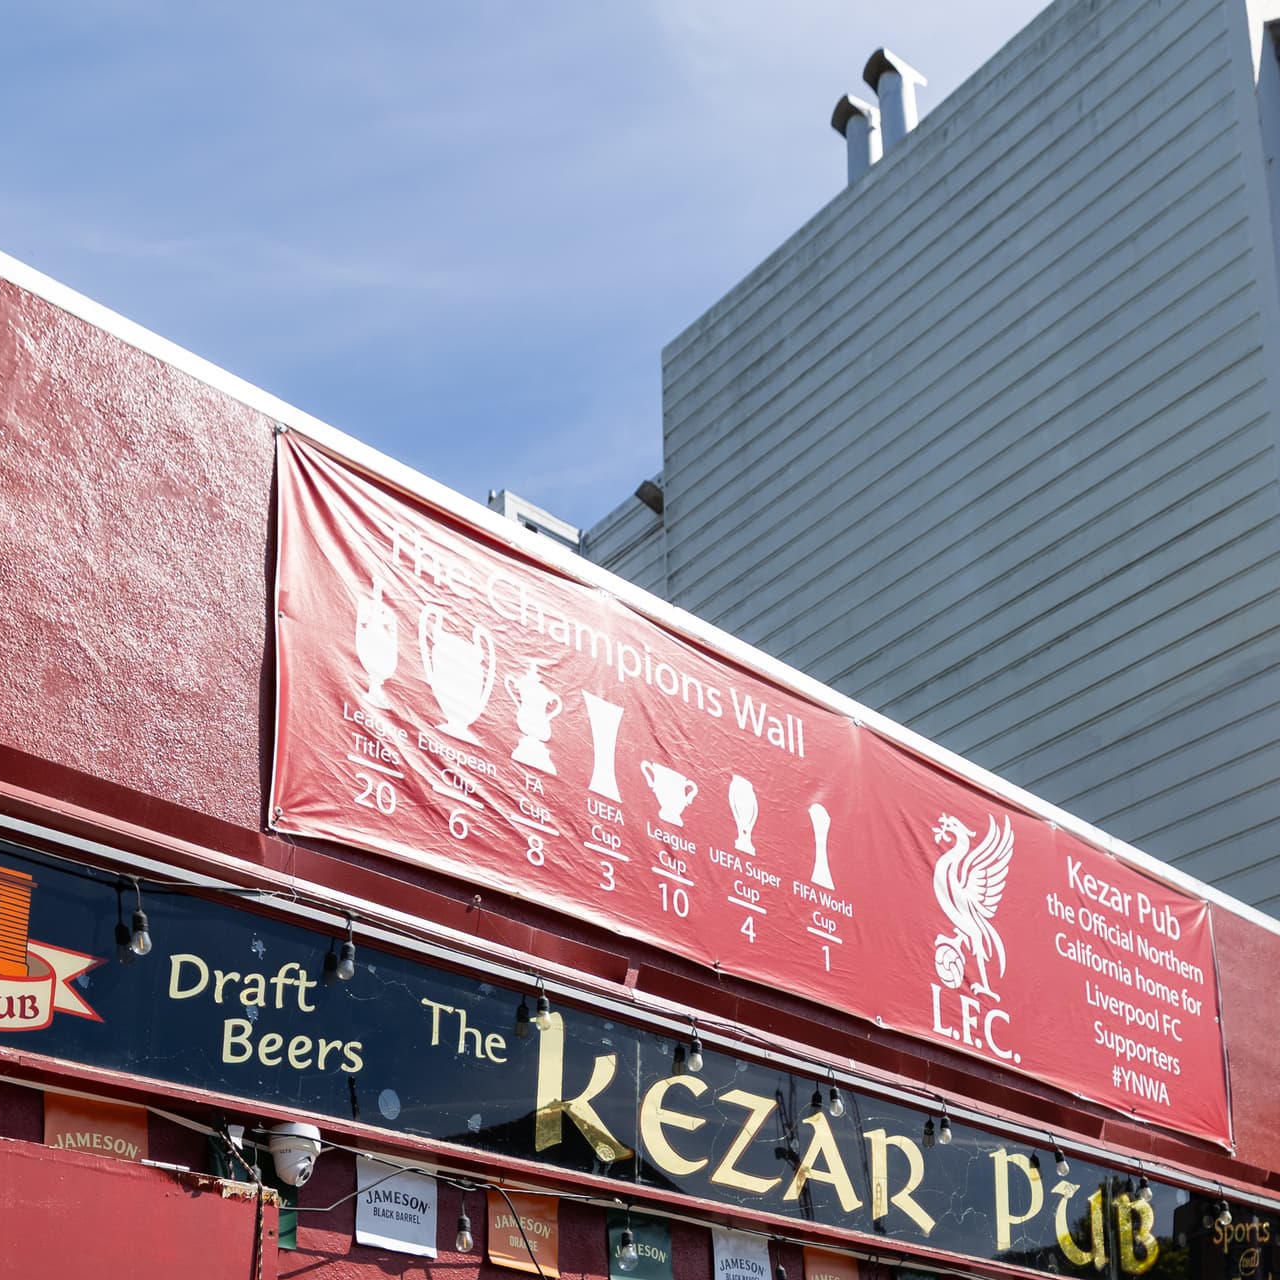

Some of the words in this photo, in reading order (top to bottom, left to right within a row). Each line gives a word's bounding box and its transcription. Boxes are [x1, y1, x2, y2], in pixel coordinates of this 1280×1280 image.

[390, 523, 478, 600] The
[486, 571, 723, 719] Champions
[729, 687, 805, 758] Wall
[342, 701, 409, 742] League
[351, 732, 401, 766] Titles
[417, 731, 497, 778] European
[353, 772, 397, 816] 20
[440, 768, 477, 794] Cup
[524, 774, 545, 796] FA
[448, 808, 469, 840] 6
[519, 798, 552, 825] Cup
[587, 797, 625, 826] UEFA
[526, 835, 545, 867] 8
[591, 825, 621, 850] Cup
[646, 821, 697, 855] League
[599, 861, 616, 892] 3
[658, 850, 687, 875] Cup
[709, 846, 744, 873] UEFA
[745, 861, 782, 889] Super
[658, 883, 689, 918] 10
[733, 879, 761, 902] Cup
[793, 880, 819, 903] FIFA
[818, 889, 853, 917] World
[1066, 855, 1133, 918] Kezar
[1138, 902, 1181, 941] Pub
[740, 916, 757, 943] 4
[812, 910, 837, 933] Cup
[1046, 893, 1076, 924] the
[1078, 903, 1135, 952] Official
[1136, 936, 1205, 986] Northern
[821, 945, 831, 971] 1
[1054, 932, 1133, 988] California
[1135, 965, 1181, 1006] home
[1180, 982, 1203, 1018] for
[169, 953, 318, 1014] Draft
[930, 982, 1022, 1064] L.F.C.
[1085, 981, 1160, 1035] Liverpool
[1162, 1015, 1183, 1043] FC
[222, 1019, 364, 1074] Beers
[1093, 1020, 1181, 1076] Supporters
[1111, 1065, 1171, 1107] #YNWA
[421, 996, 509, 1065] The
[530, 1012, 937, 1238] KEZAR
[54, 1132, 139, 1160] JAMESON
[366, 1189, 429, 1215] JAMESON
[372, 1206, 395, 1220] BLACK
[395, 1210, 421, 1225] BARREL
[494, 1214, 551, 1240] JAMESON
[1213, 1217, 1270, 1254] Sports
[719, 1257, 764, 1277] JAMESON
